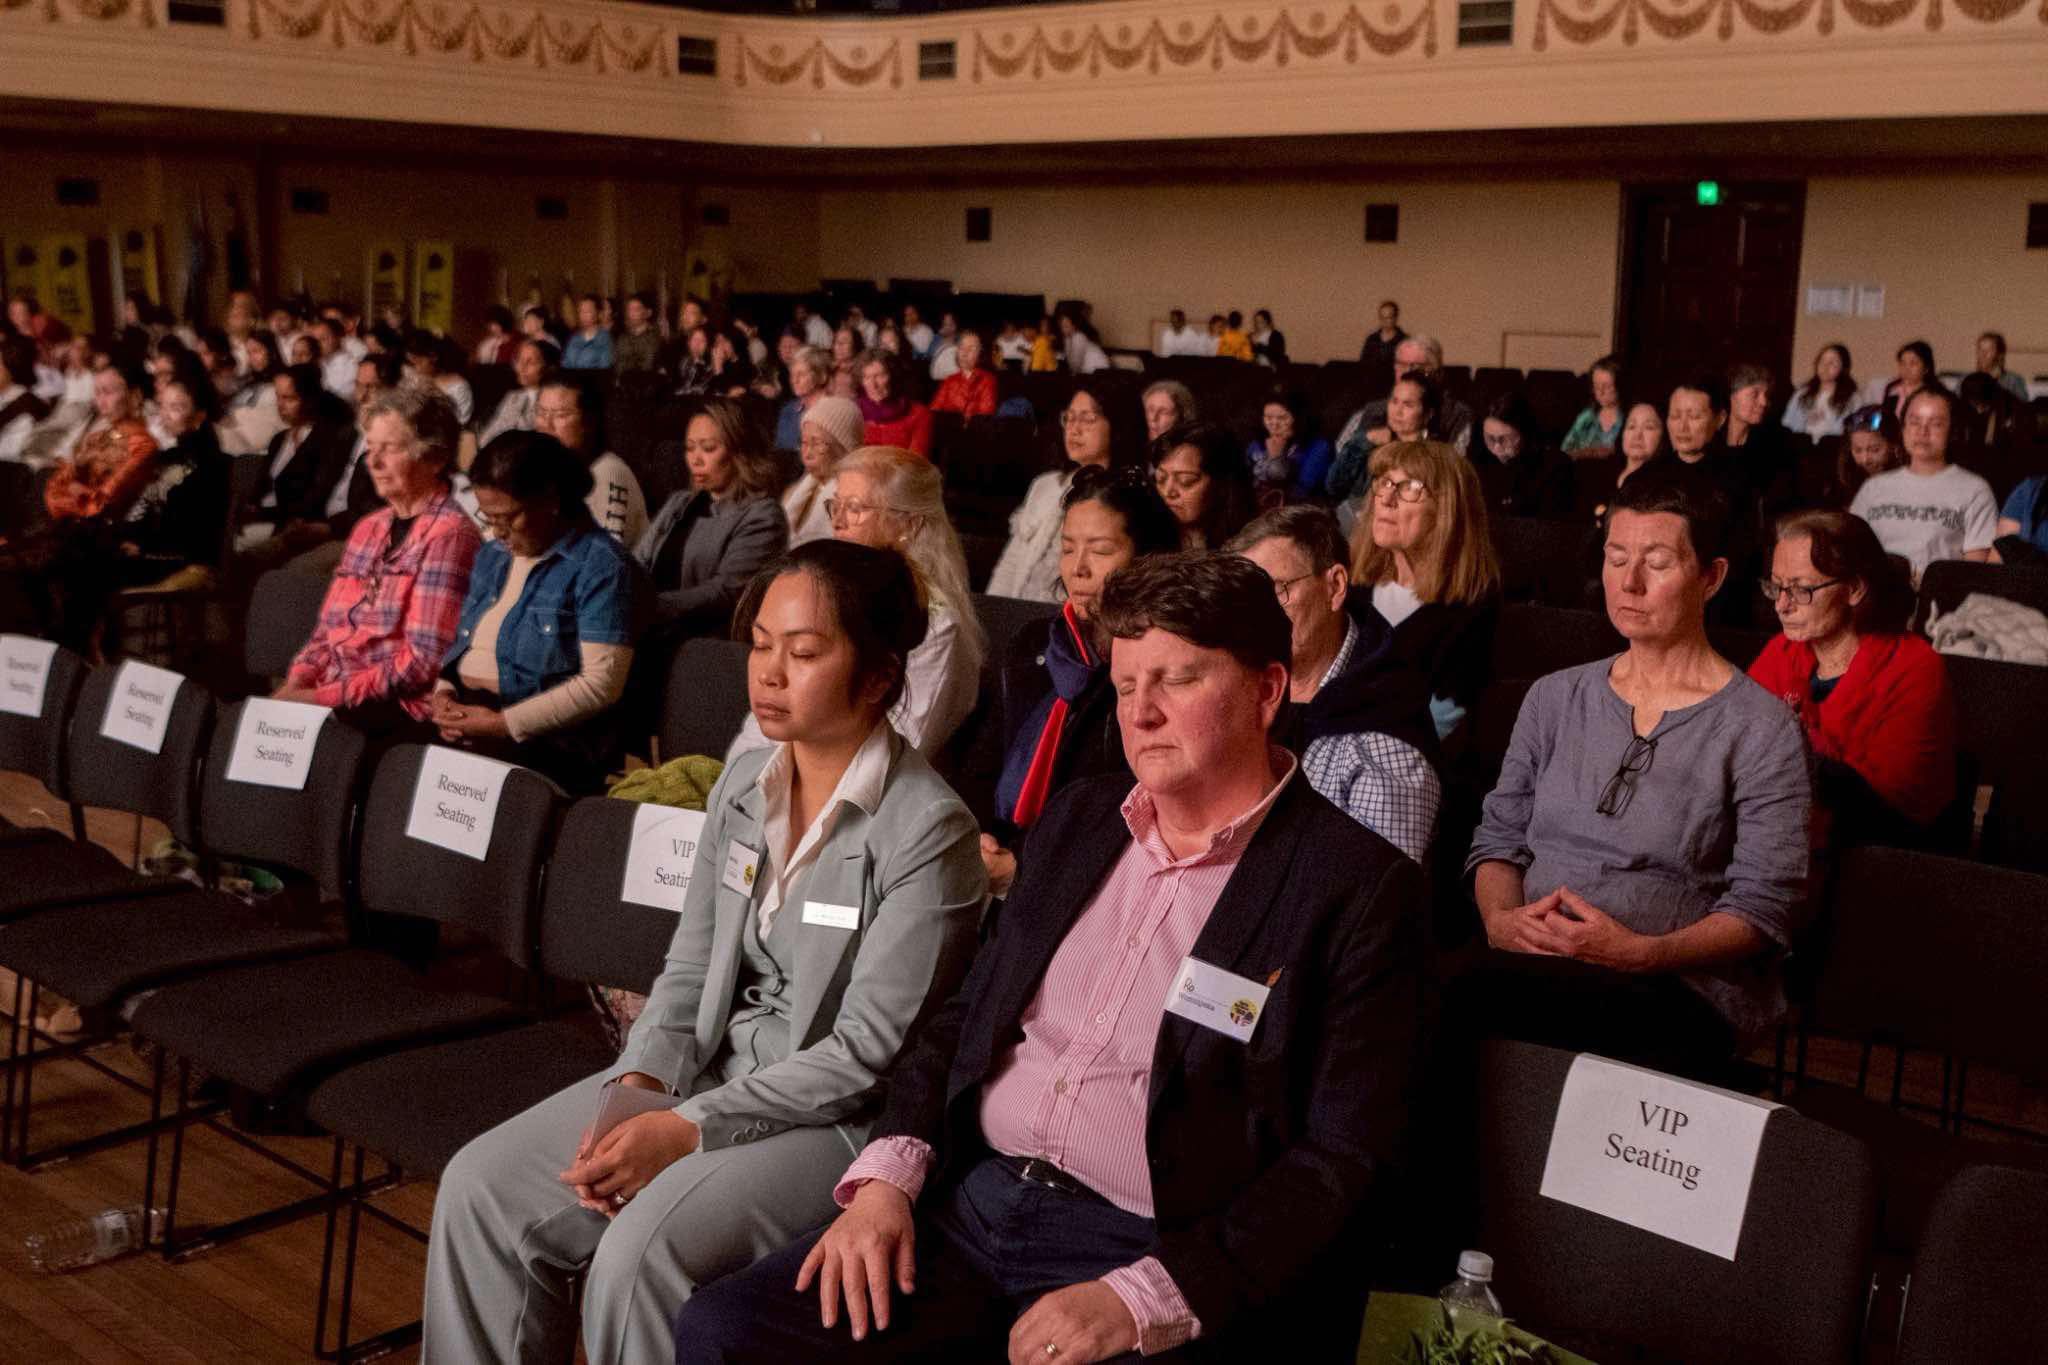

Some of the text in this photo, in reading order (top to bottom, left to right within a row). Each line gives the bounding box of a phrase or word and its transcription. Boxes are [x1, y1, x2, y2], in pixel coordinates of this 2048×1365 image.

[256, 720, 306, 741] Reserved
[255, 744, 295, 767] Seating
[438, 774, 488, 802] Reserved
[434, 801, 476, 832] Seating
[672, 838, 695, 858] VIP
[1640, 1100, 1689, 1136] VIP
[1604, 1132, 1702, 1191] Seating
